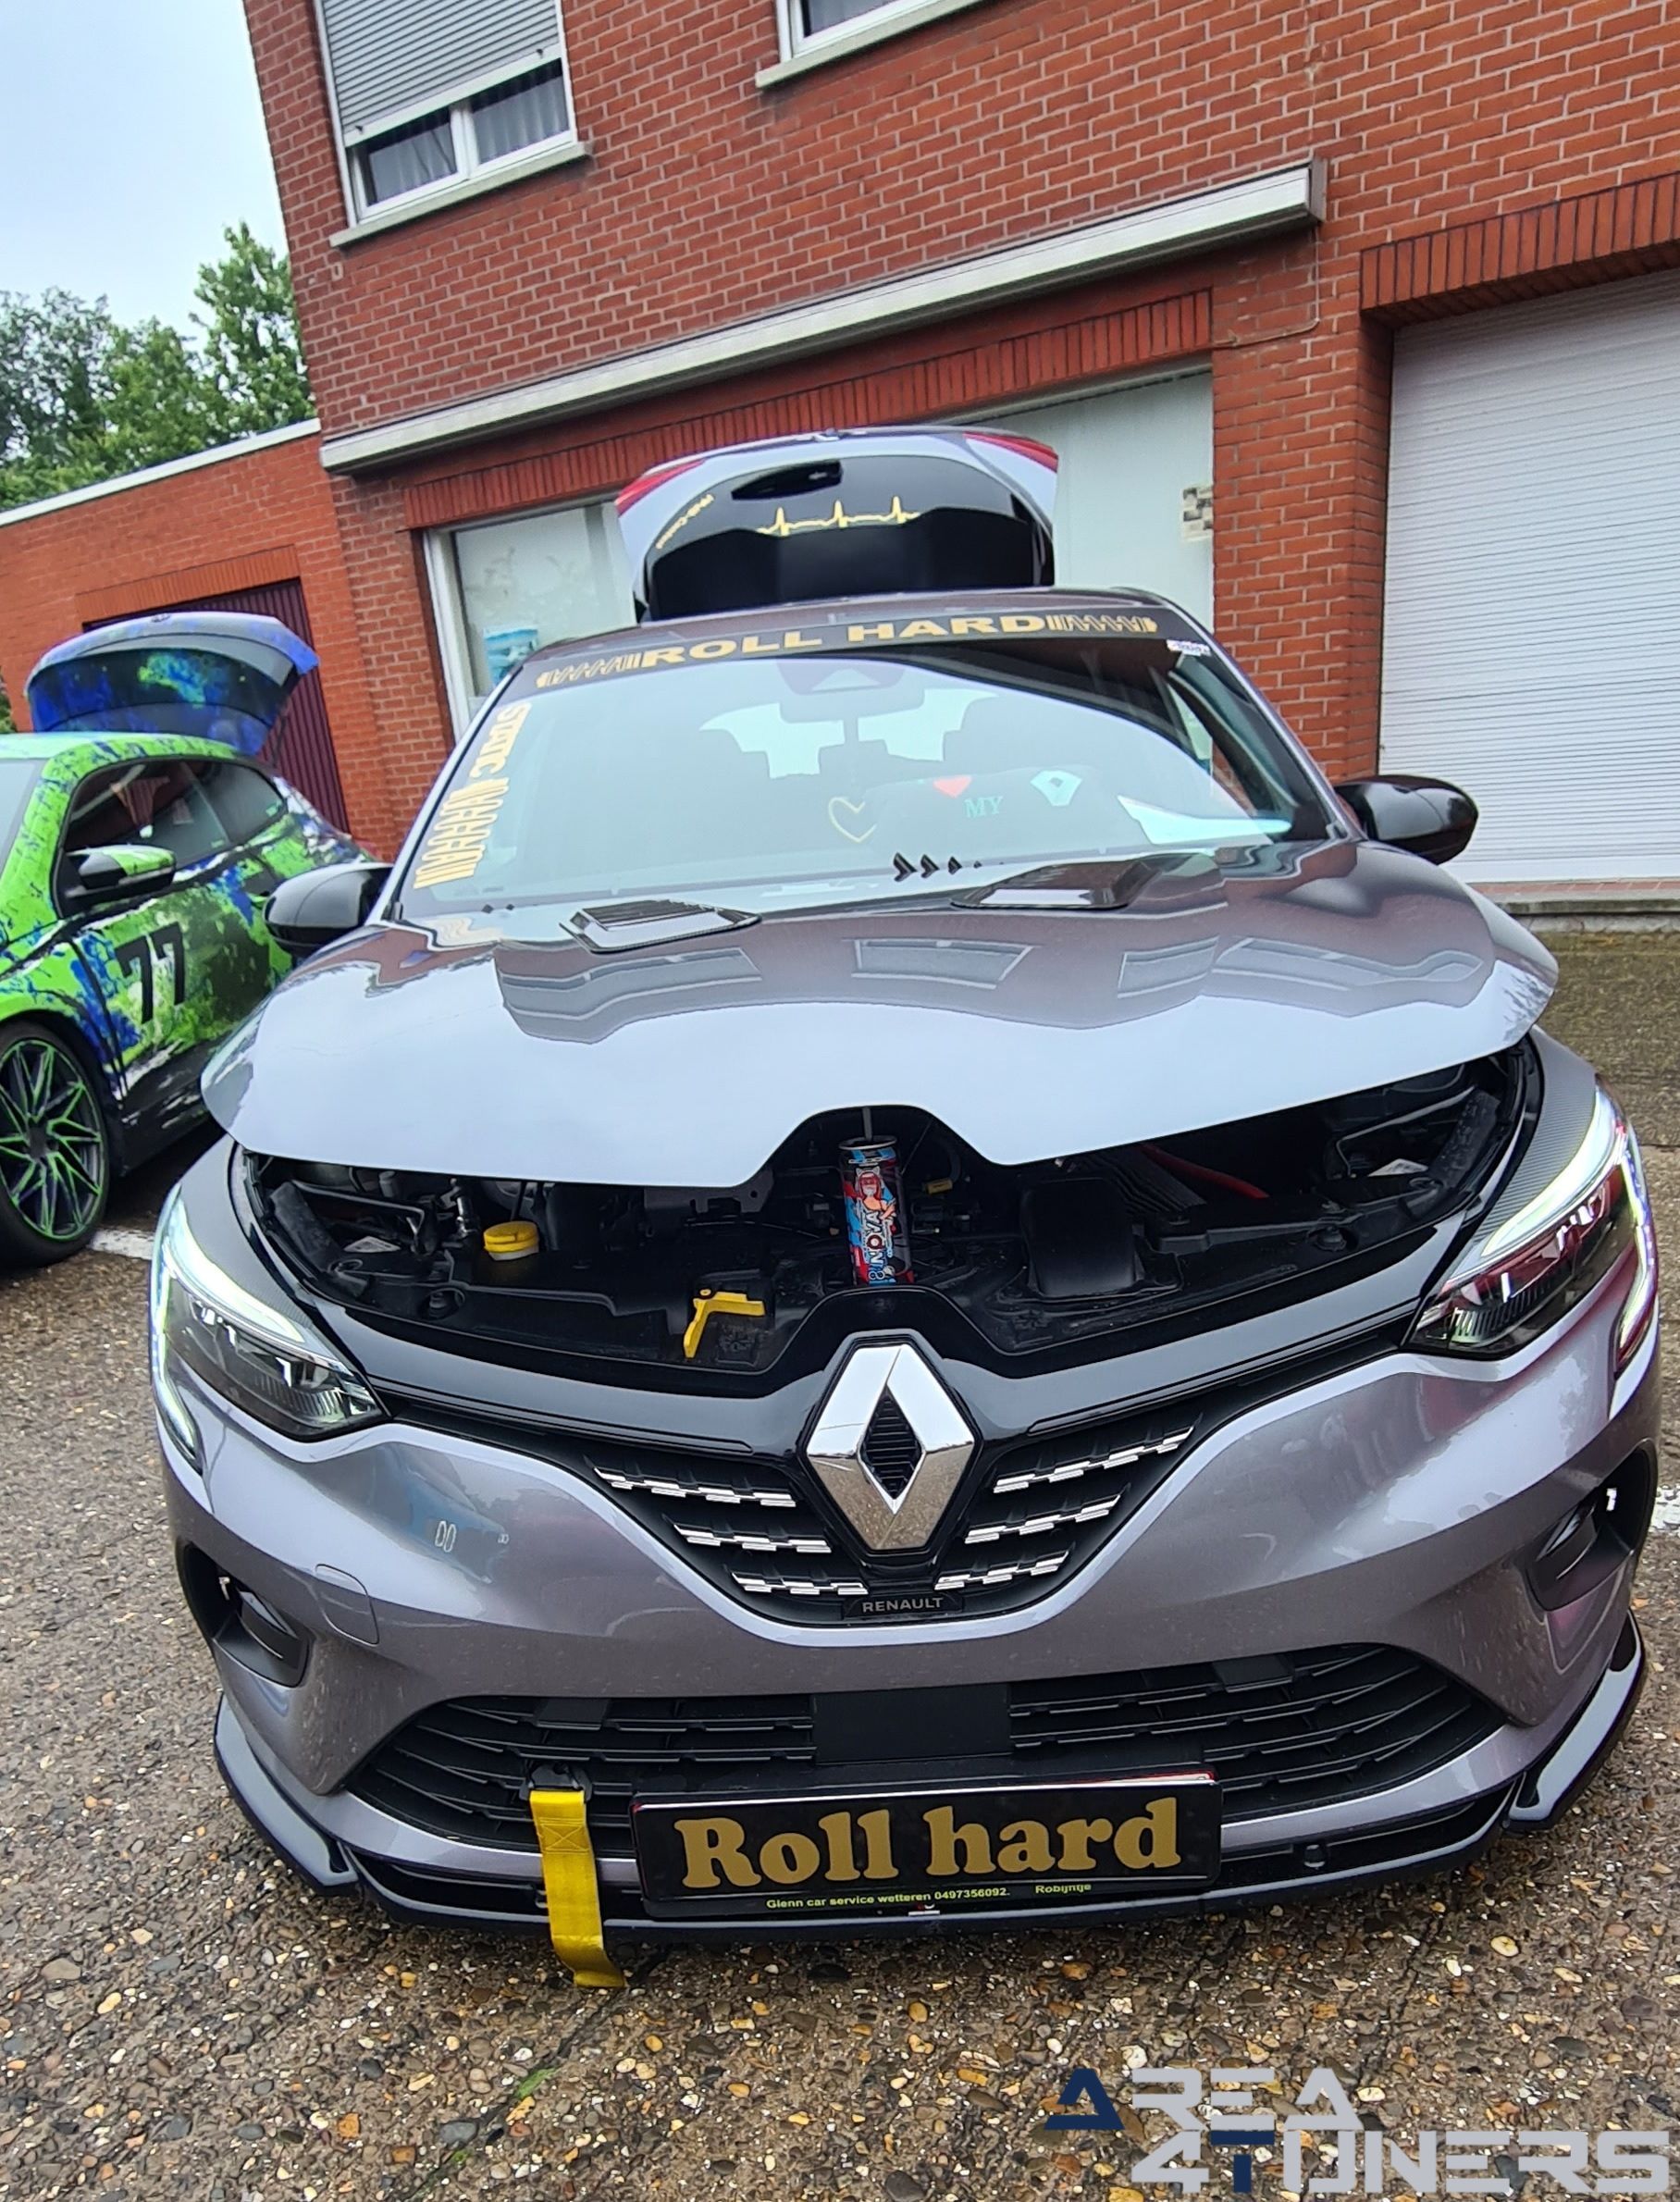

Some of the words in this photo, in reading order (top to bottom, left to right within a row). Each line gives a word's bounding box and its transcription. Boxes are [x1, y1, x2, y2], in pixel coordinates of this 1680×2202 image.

[642, 631, 822, 667] ROLL
[847, 615, 1045, 642] HARD
[964, 796, 1004, 819] MY
[114, 922, 185, 1024] 77
[861, 1597, 944, 1613] RENAULT
[673, 1810, 899, 1888] Roll
[923, 1797, 1181, 1875] hard
[766, 1899, 803, 1909] Glenn
[807, 1898, 826, 1907] car
[830, 1895, 874, 1906] service
[877, 1892, 932, 1904] wetteren
